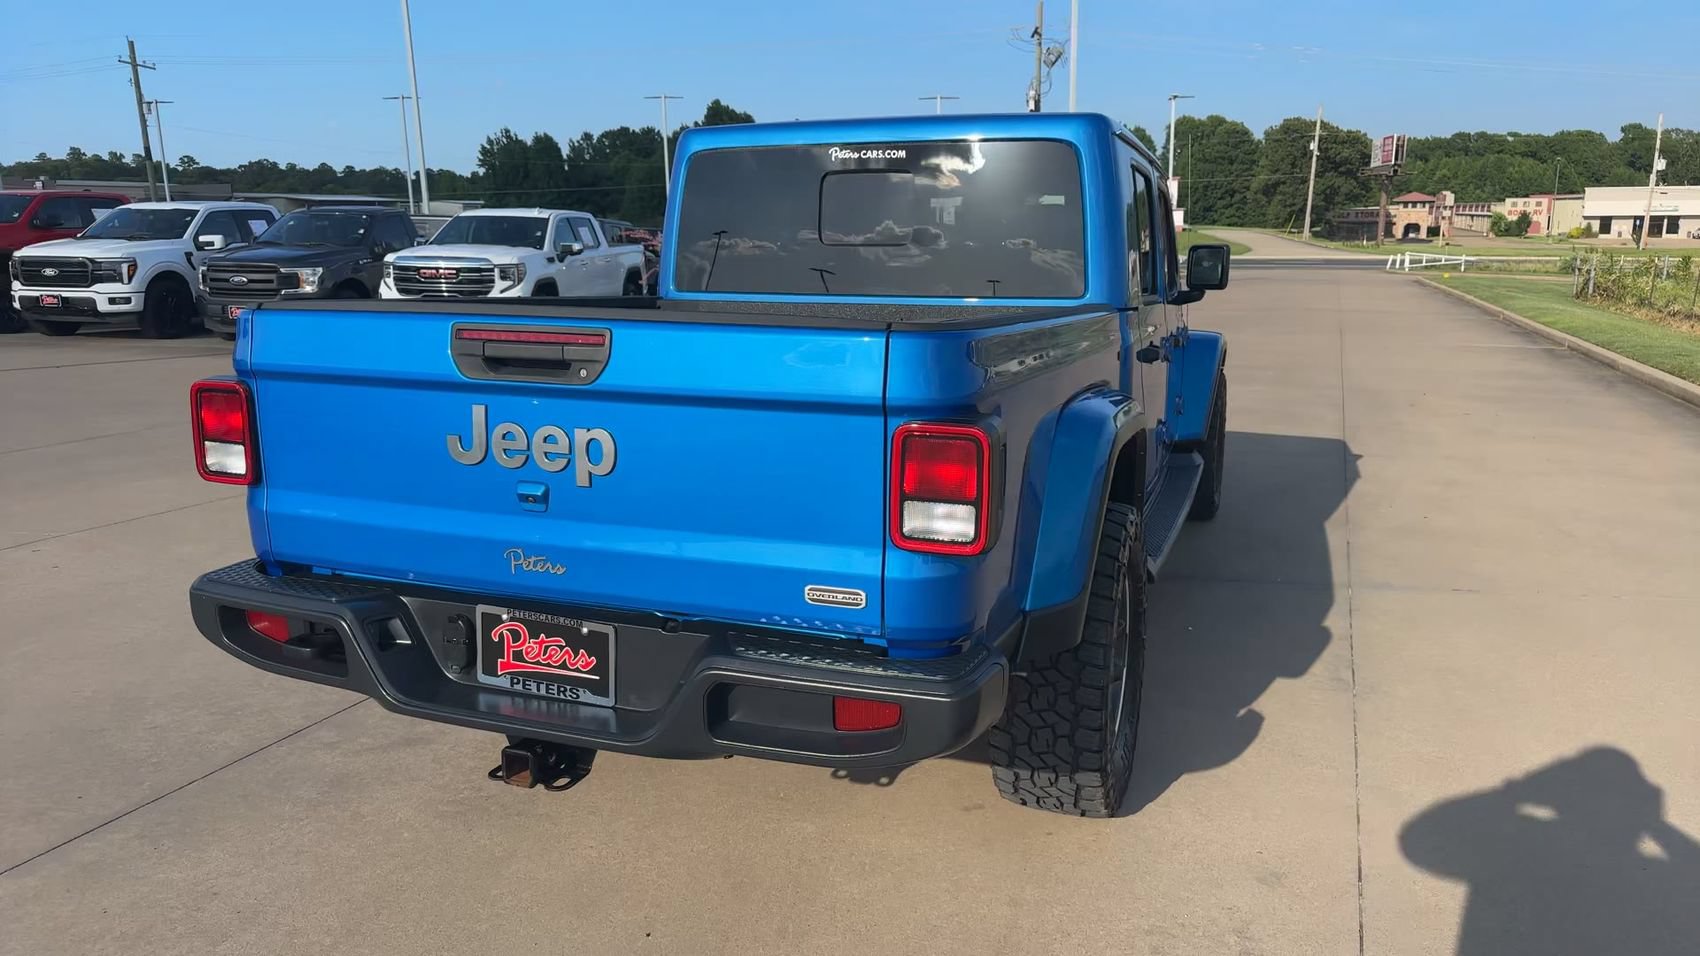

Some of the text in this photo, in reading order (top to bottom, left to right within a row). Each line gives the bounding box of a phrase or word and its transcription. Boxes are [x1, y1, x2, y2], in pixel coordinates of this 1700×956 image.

[828, 147, 907, 161] Peters CARS.COM
[1532, 208, 1544, 217] RV
[419, 269, 457, 278] GMC
[446, 404, 617, 488] Jeep
[503, 548, 567, 575] Peters
[806, 592, 863, 602] OVERLAND
[506, 608, 584, 628] PETERSCARS.COM
[491, 621, 597, 675] Peters
[509, 676, 581, 700] PETERS
